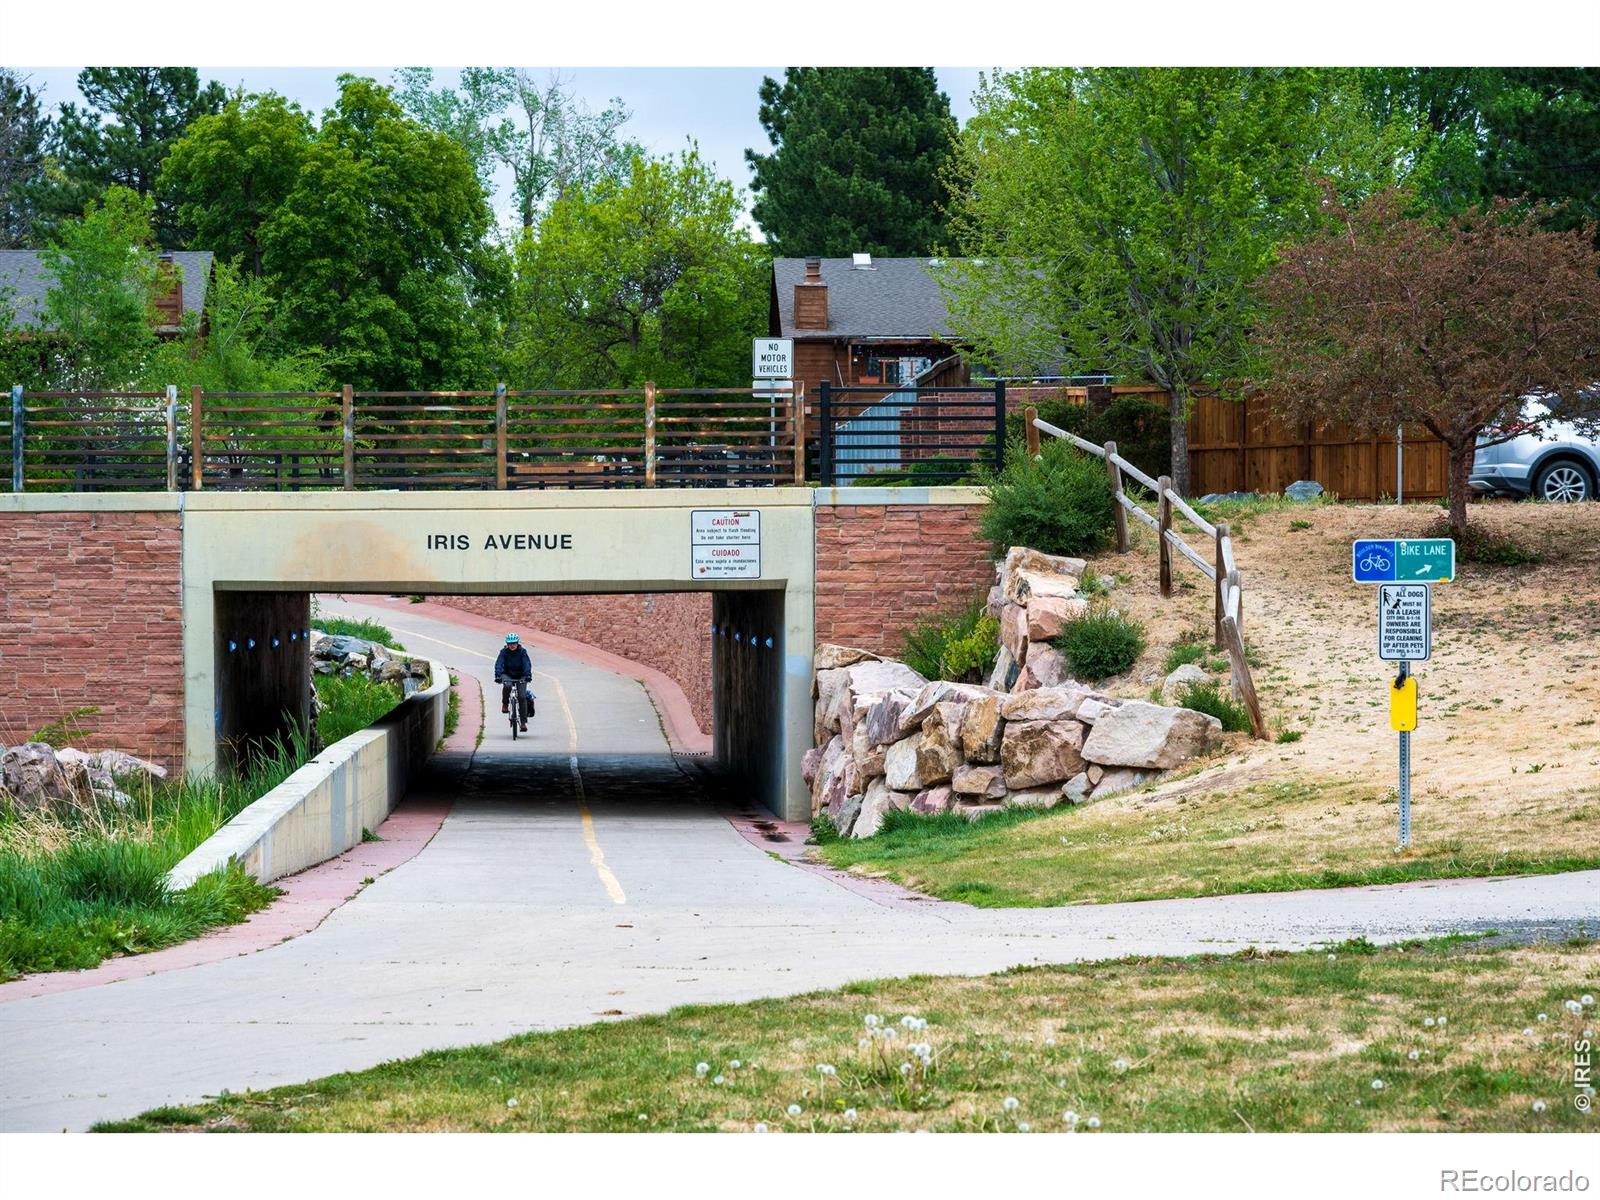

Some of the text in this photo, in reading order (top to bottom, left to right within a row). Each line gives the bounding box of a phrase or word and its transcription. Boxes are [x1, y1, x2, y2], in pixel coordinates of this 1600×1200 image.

[428, 534, 572, 550] IRIS AVENUE
[1401, 545, 1446, 556] BIKE LANE
